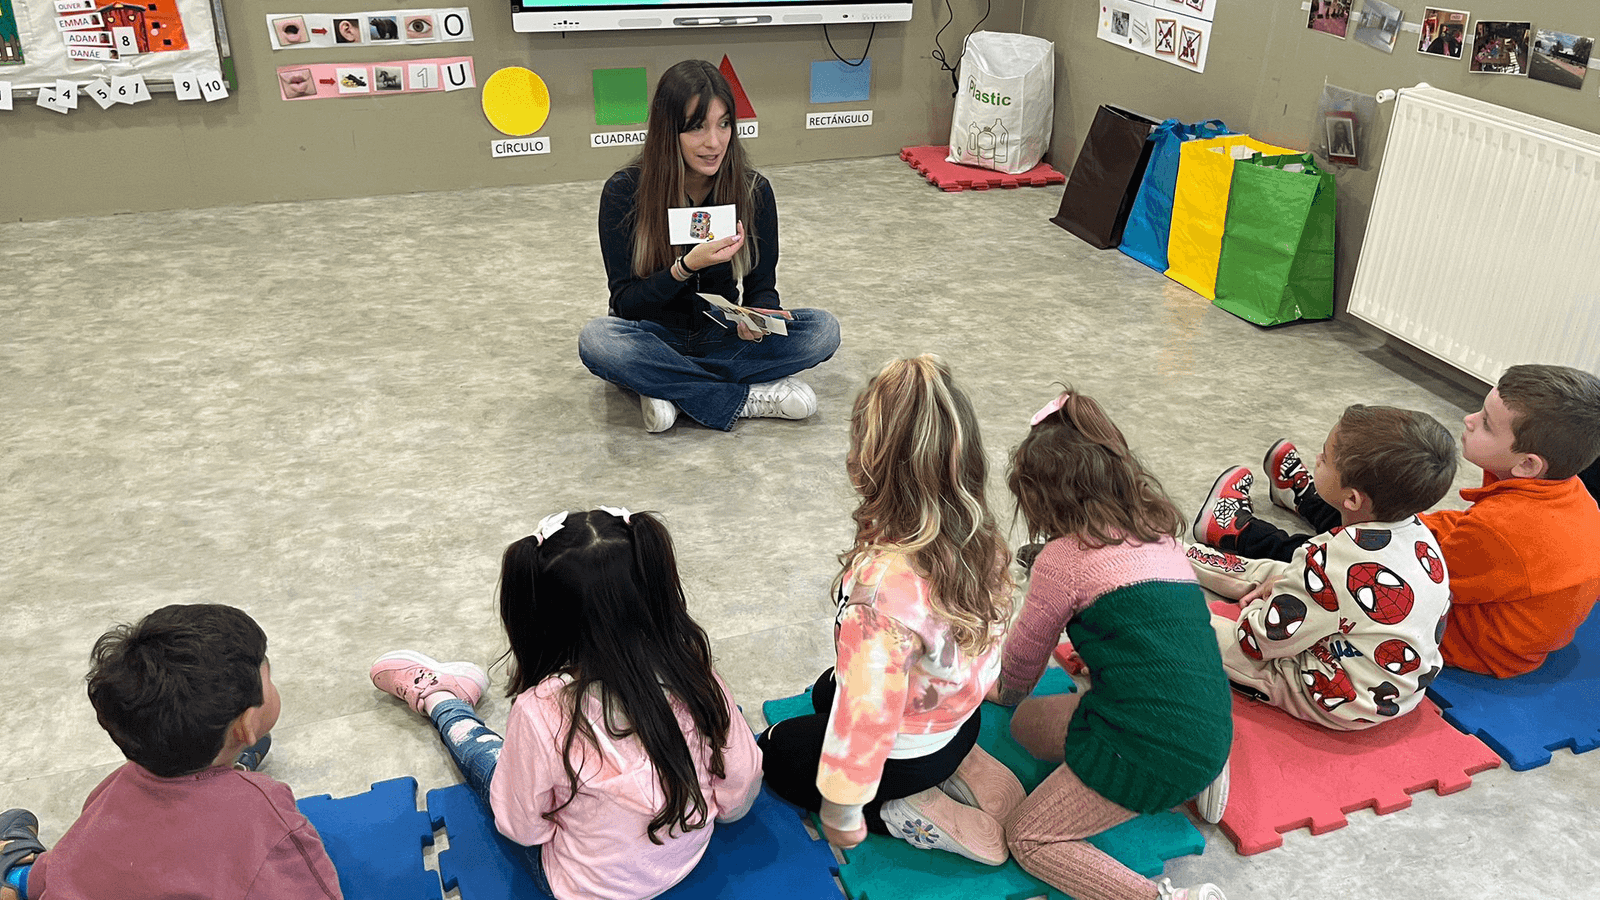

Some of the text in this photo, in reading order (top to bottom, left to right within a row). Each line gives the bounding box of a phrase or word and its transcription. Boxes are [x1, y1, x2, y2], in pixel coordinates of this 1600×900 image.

[59, 18, 89, 28] EMMA
[444, 14, 464, 36] O
[69, 34, 97, 43] ADAM
[122, 36, 130, 47] 8
[70, 49, 100, 58] DANÁE
[447, 64, 466, 86] U
[118, 85, 126, 95] 6
[182, 81, 190, 91] 9
[205, 80, 221, 92] 10
[62, 89, 71, 99] 4
[96, 89, 107, 99] 5
[968, 80, 1011, 106] Plastic
[809, 114, 869, 126] RECTÁNGULO
[594, 132, 647, 145] CUADRAD
[495, 141, 544, 154] CÍRCULO
